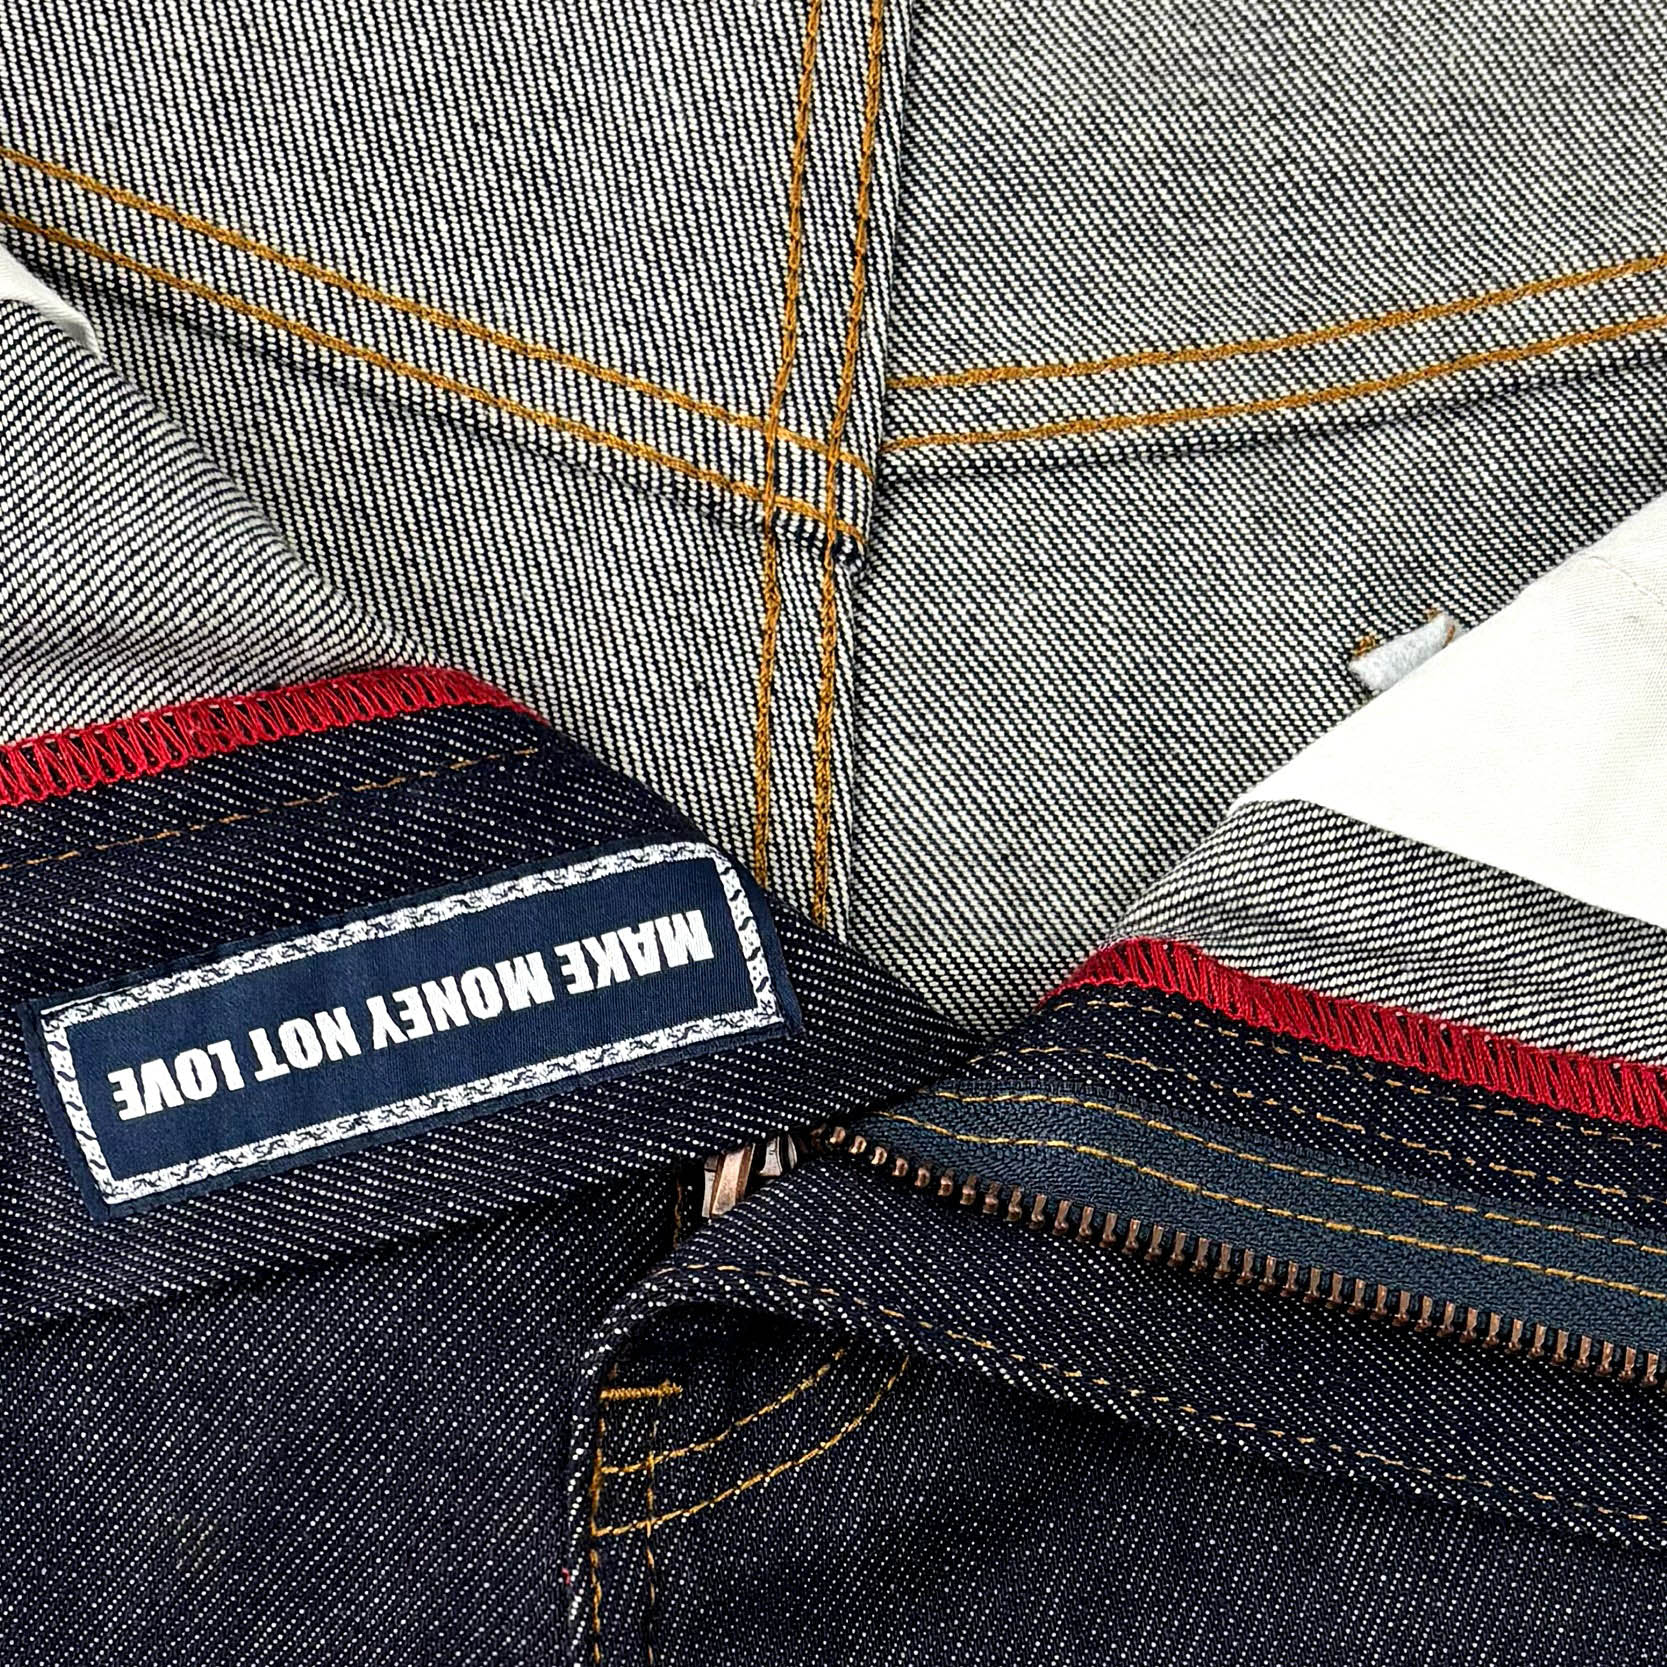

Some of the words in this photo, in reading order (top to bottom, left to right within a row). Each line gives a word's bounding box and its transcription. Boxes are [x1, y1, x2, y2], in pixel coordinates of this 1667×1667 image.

[553, 909, 715, 995] MAKE
[365, 951, 556, 1051] MONEY
[107, 1039, 245, 1121] LOVE
[248, 1006, 362, 1082] NOT
